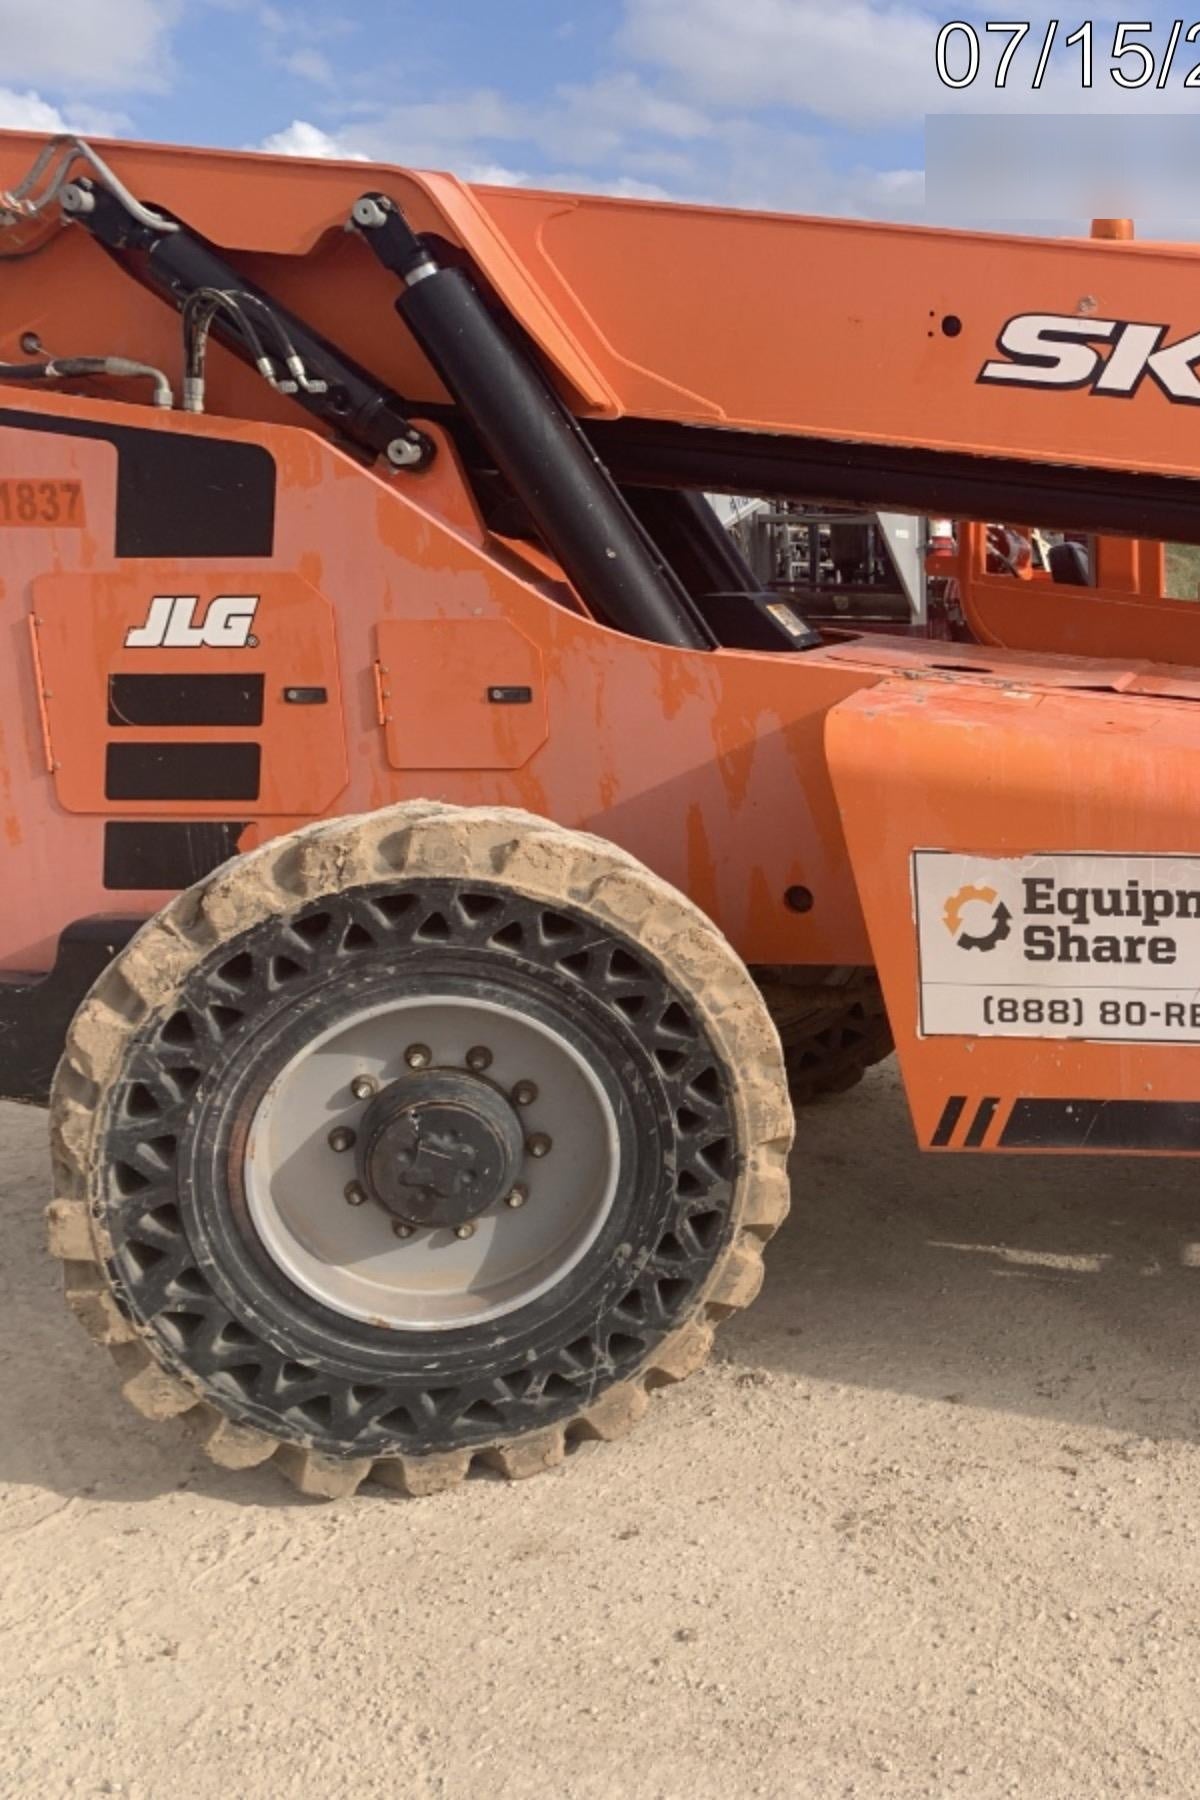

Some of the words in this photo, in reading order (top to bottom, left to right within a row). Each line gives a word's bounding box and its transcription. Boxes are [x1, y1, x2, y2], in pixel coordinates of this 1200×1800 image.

[124, 594, 258, 649] JLG
[1023, 925, 1177, 964] Share
[983, 995, 1084, 1027] (888)
